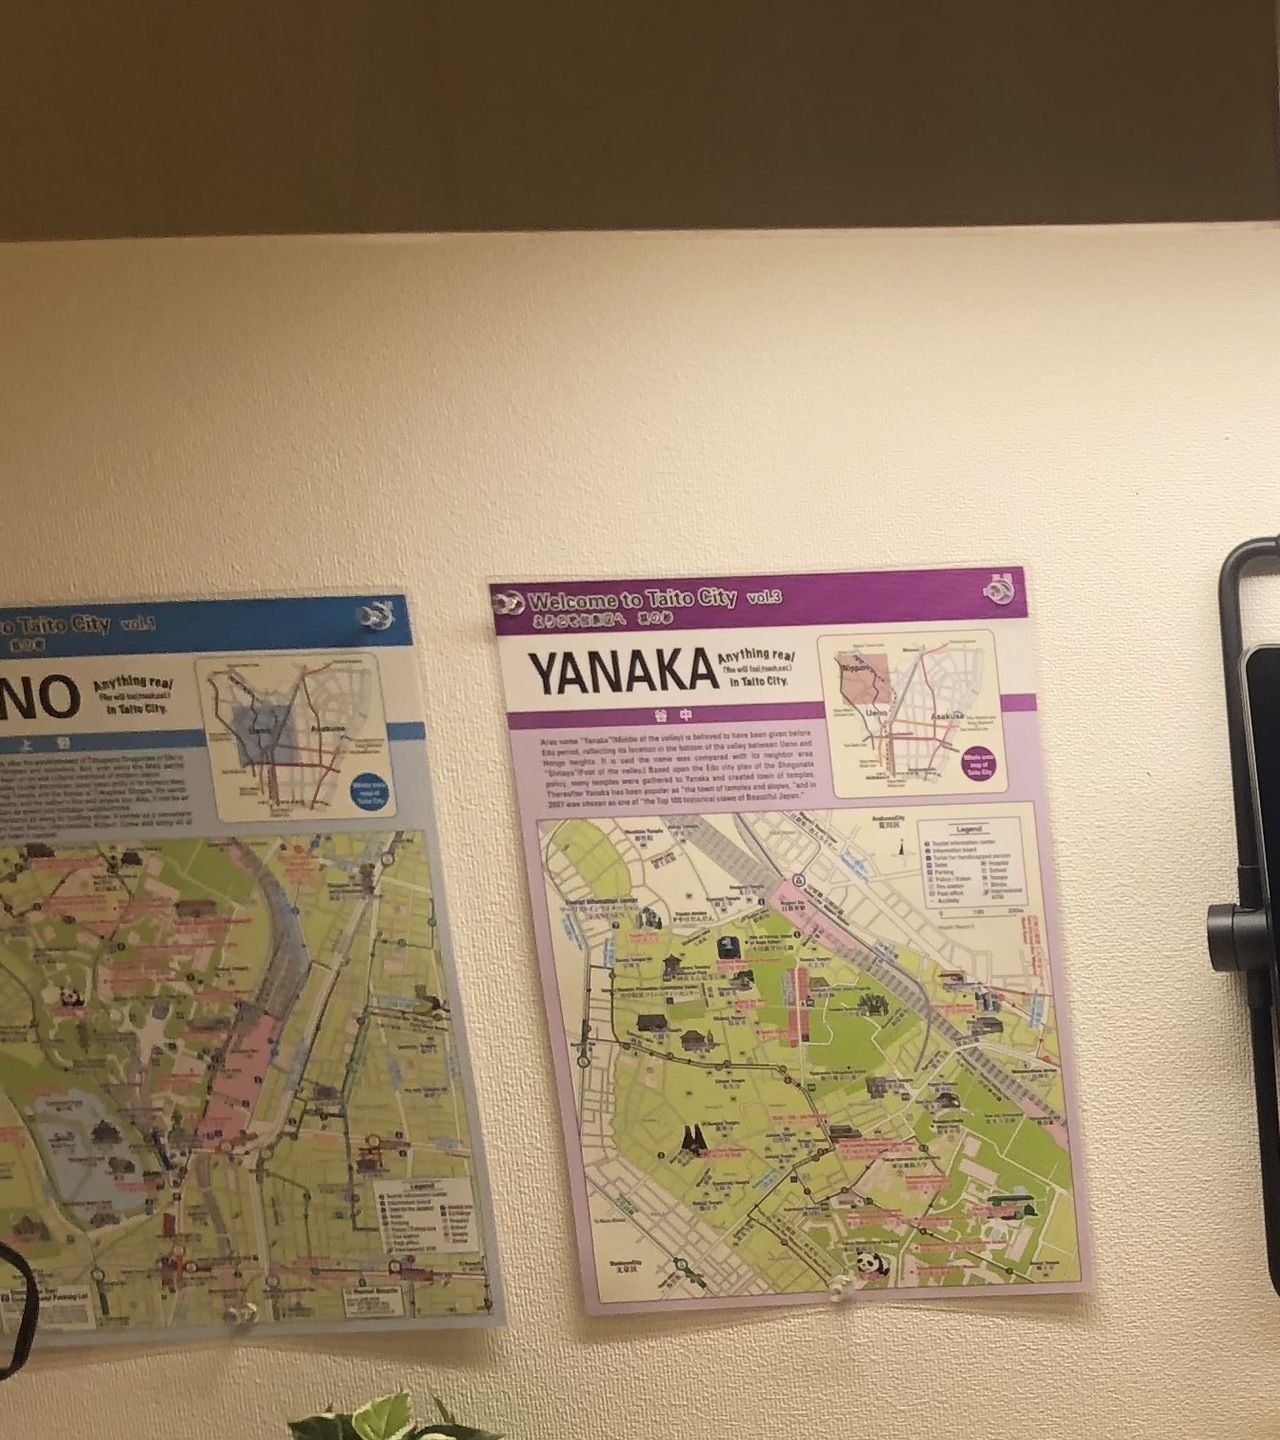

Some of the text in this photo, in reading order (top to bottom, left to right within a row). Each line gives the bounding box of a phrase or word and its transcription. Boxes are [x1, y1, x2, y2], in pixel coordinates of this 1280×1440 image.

[528, 587, 783, 611] Welcome to Taito City vol.3
[18, 616, 67, 634] Taito
[72, 613, 111, 636] City
[718, 648, 795, 664] Anything real
[528, 647, 720, 695] YANAKA
[729, 676, 789, 687] in Taito City.
[93, 674, 174, 693] Anything real
[0, 674, 81, 719] NO
[106, 705, 117, 715] in
[118, 704, 142, 715] Taito
